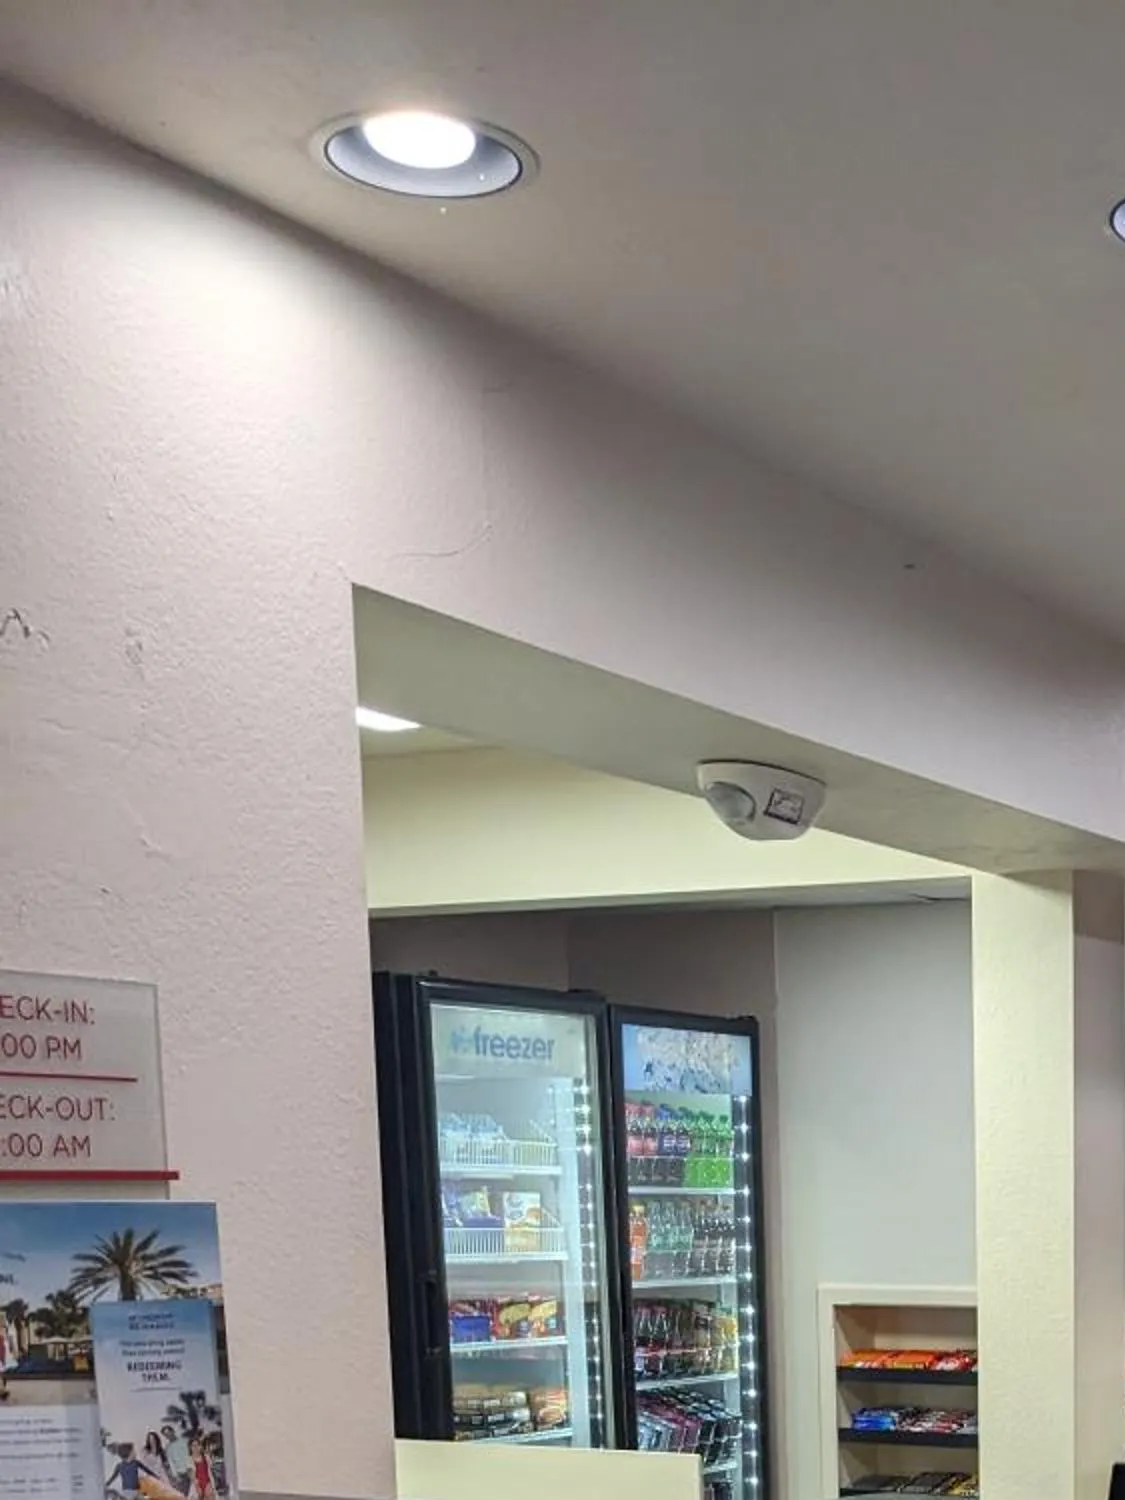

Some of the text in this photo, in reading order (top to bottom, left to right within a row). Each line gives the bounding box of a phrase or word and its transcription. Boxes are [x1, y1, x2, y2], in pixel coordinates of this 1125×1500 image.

[0, 995, 96, 1025] ECK-IN:
[46, 1035, 83, 1061] PM
[473, 1025, 555, 1060] freezer
[53, 1134, 92, 1159] AM
